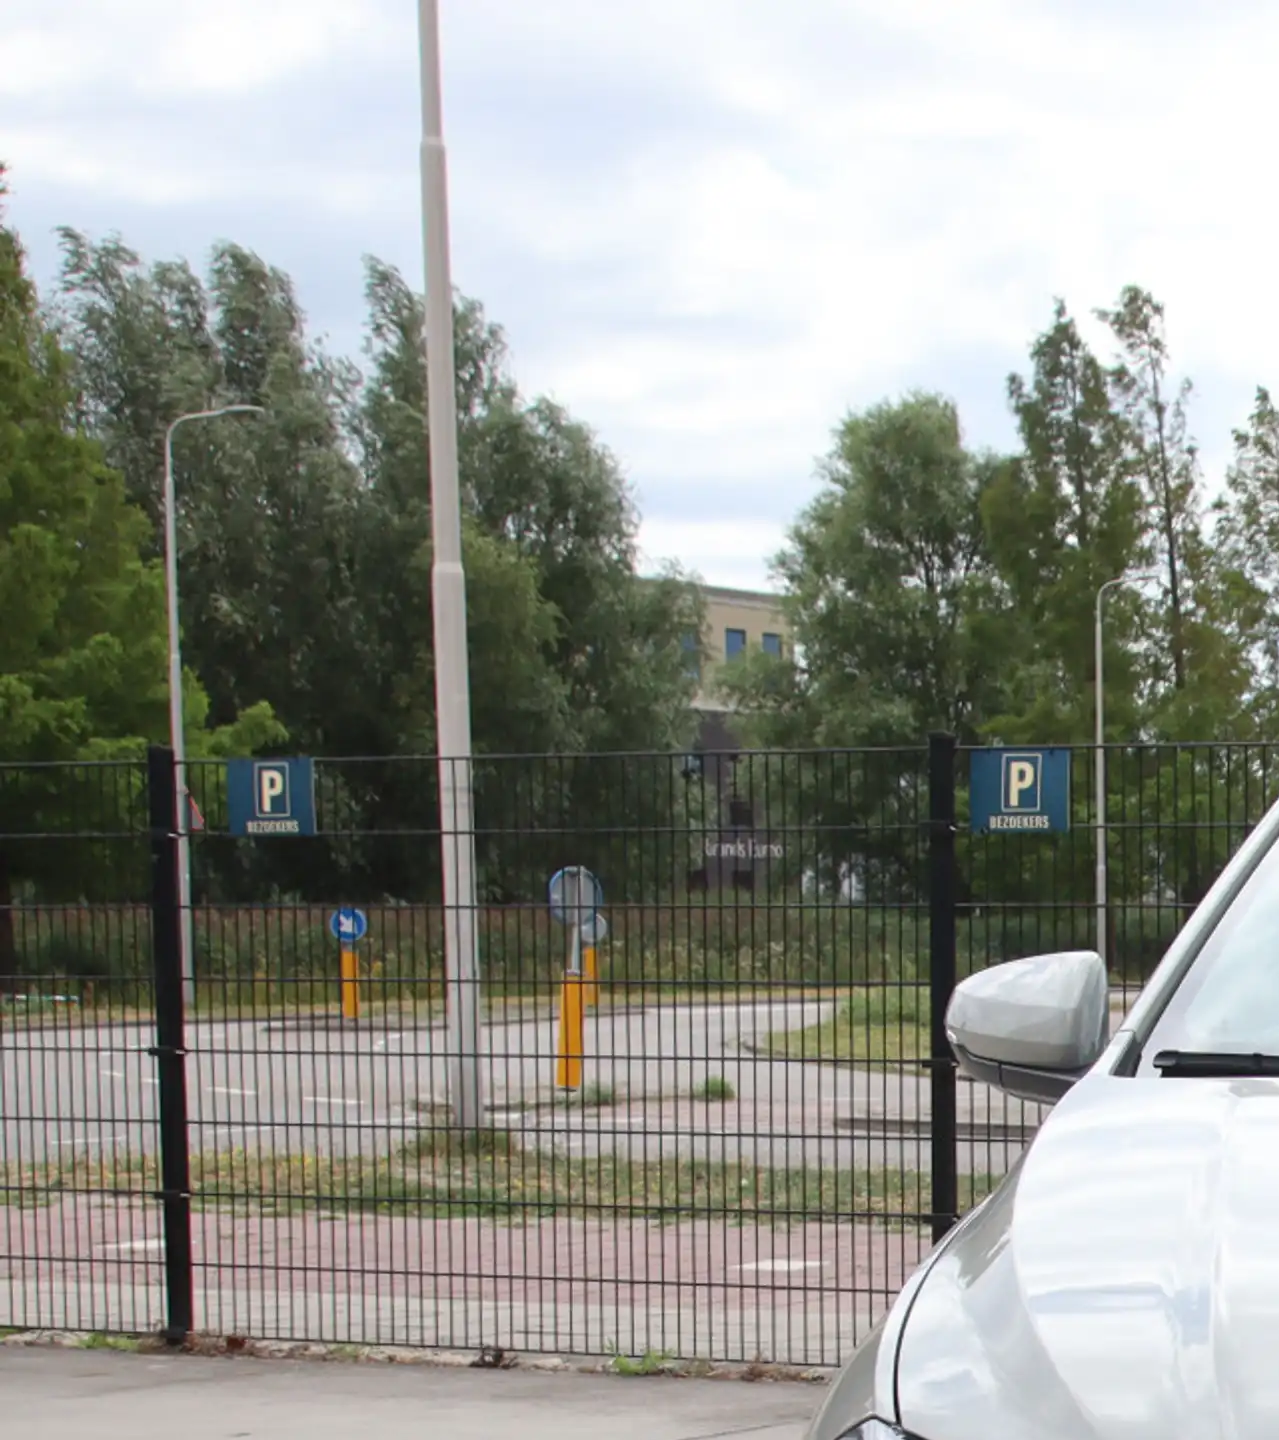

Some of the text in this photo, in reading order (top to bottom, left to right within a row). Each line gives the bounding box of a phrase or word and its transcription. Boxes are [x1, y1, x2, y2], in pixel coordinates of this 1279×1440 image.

[261, 769, 283, 813] P
[1009, 760, 1035, 807] P
[989, 815, 1049, 829] BEZOEKERS
